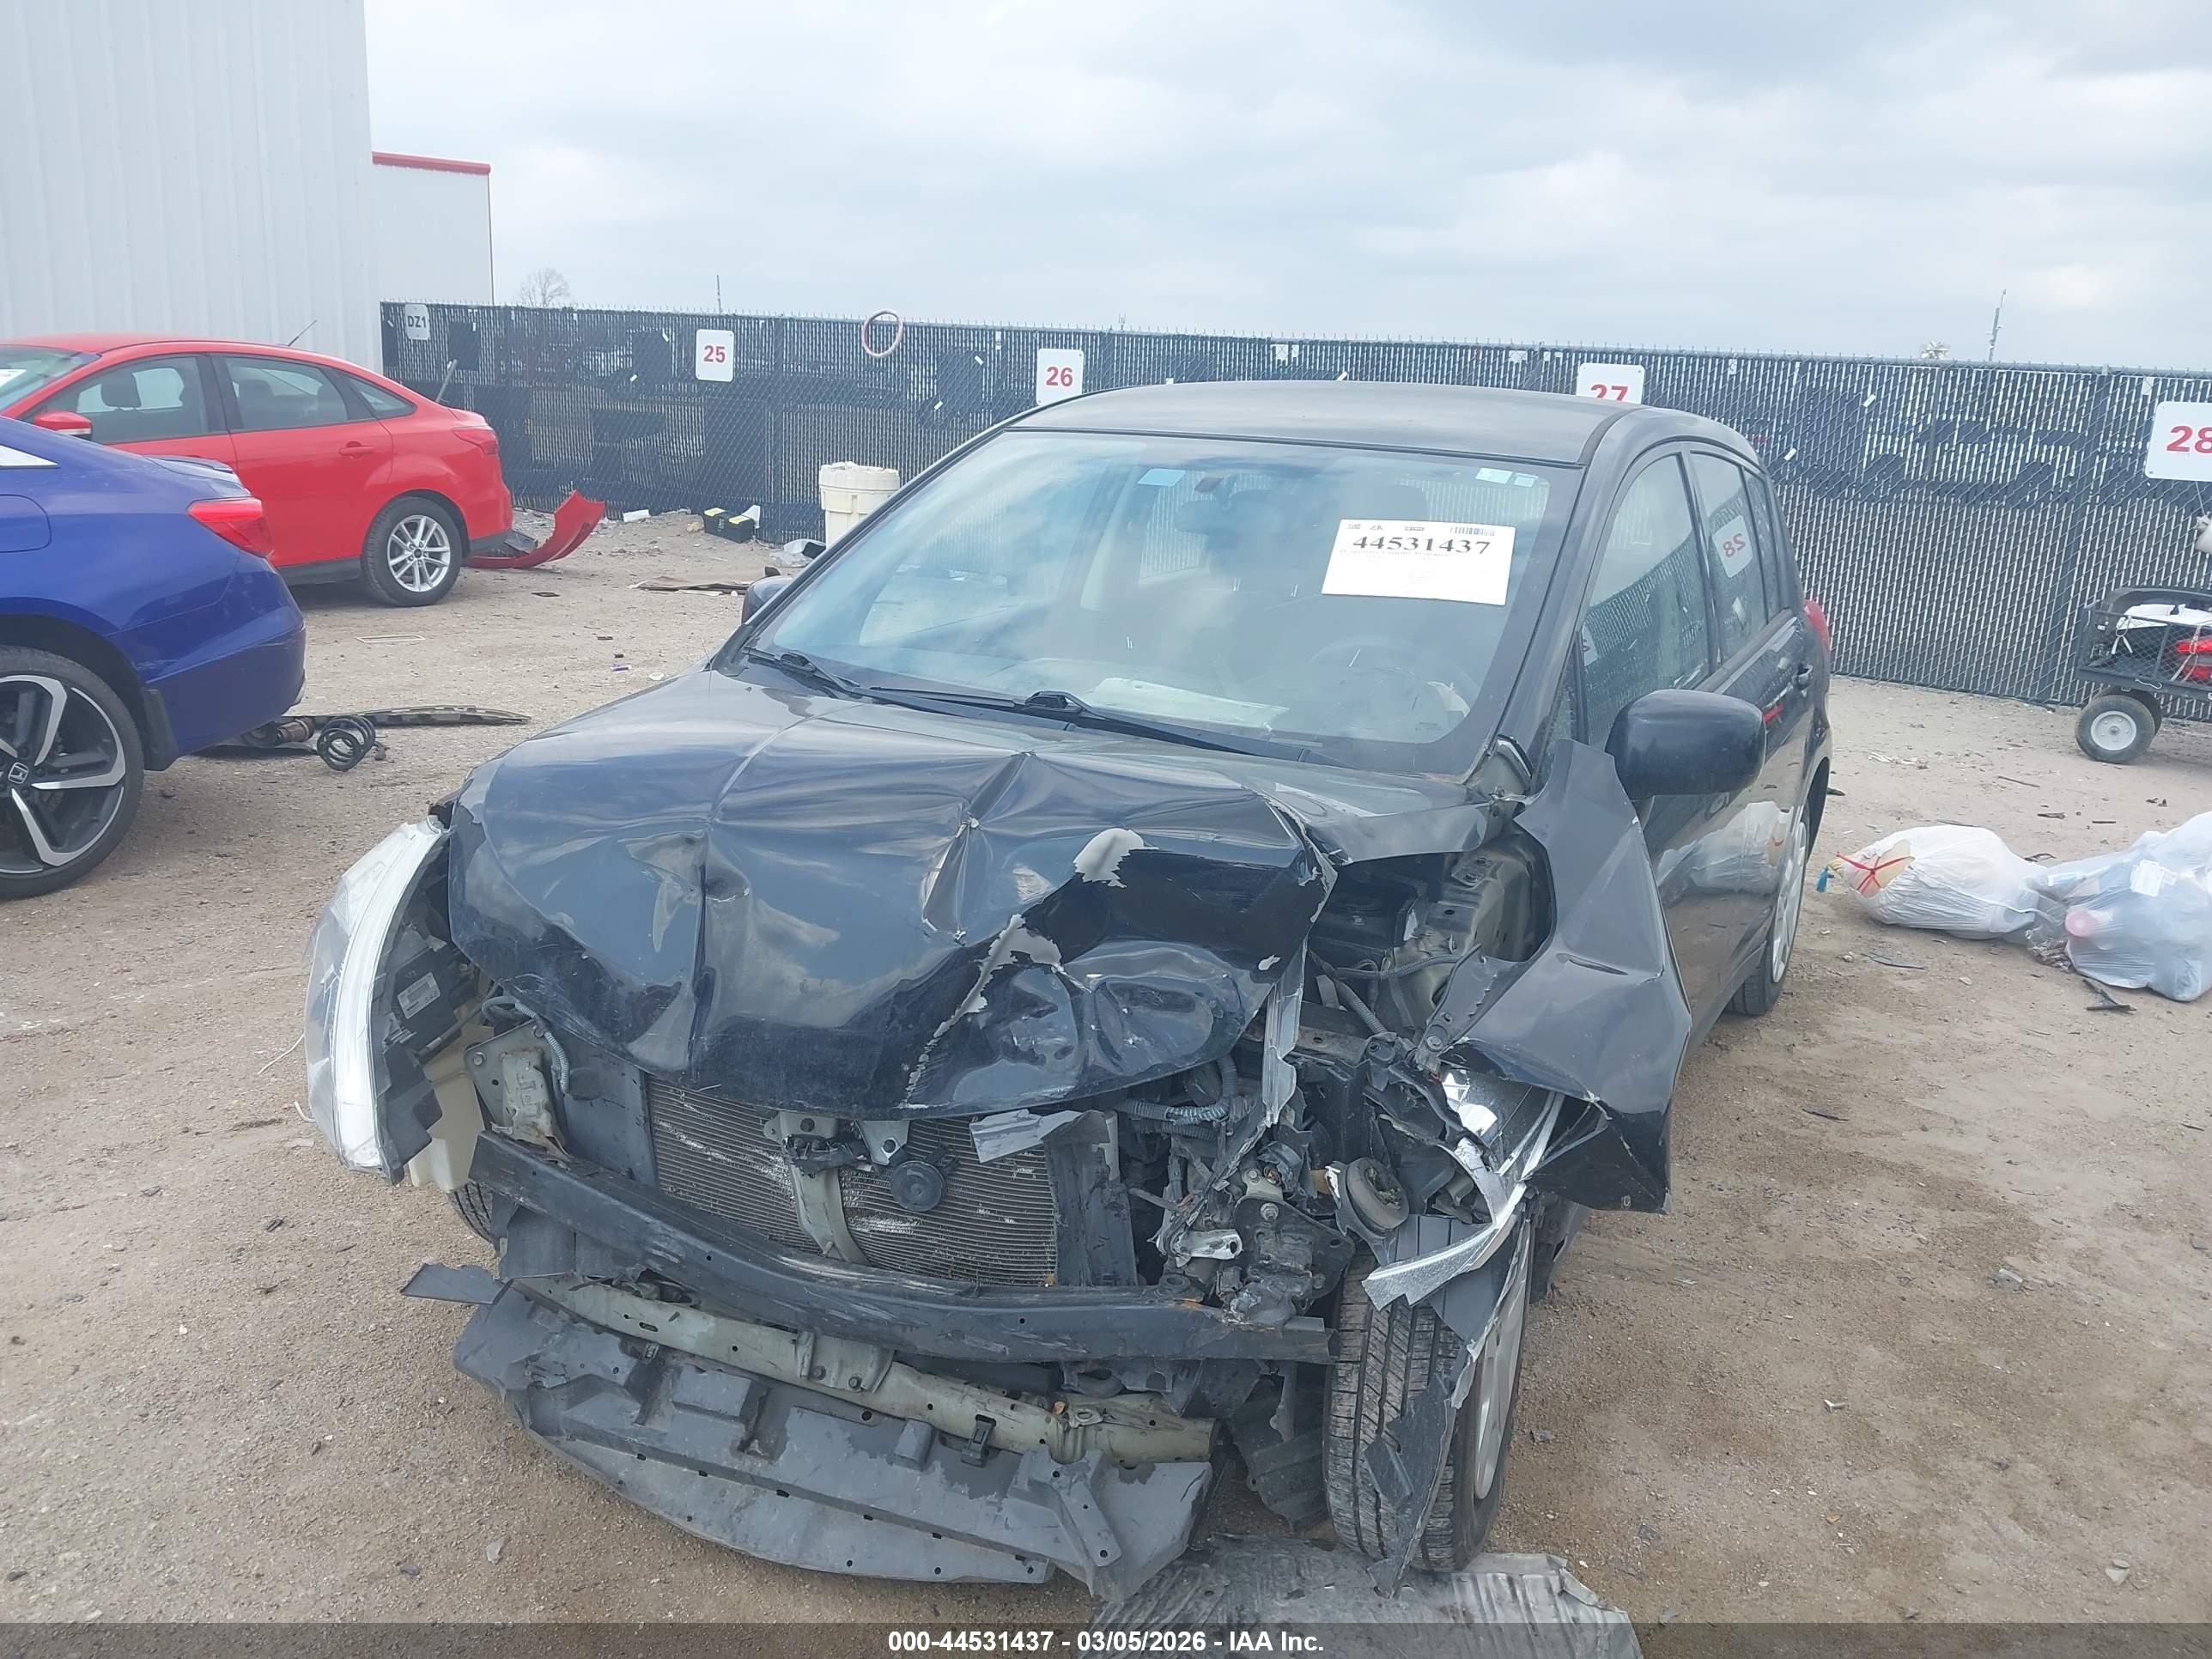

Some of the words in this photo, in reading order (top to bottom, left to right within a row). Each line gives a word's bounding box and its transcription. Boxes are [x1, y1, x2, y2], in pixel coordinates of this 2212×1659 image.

[407, 315, 427, 328] DZ1
[703, 344, 726, 363] 25
[1046, 366, 1073, 387] 26
[1590, 384, 1629, 402] 27
[2166, 425, 2212, 453] 28
[1352, 535, 1492, 556] 44531437
